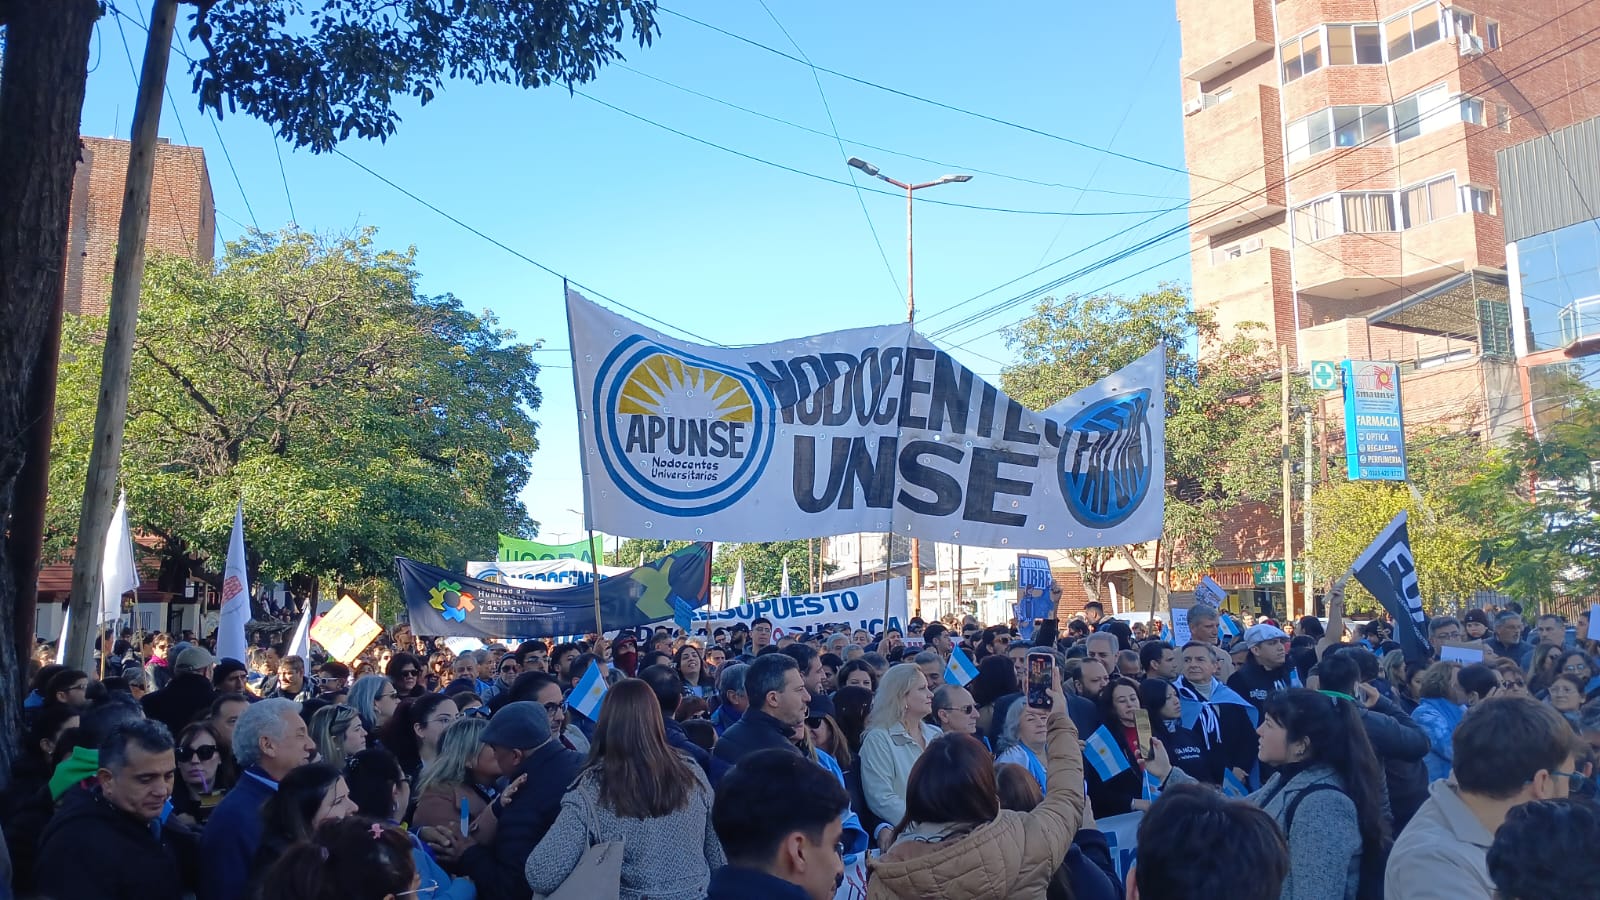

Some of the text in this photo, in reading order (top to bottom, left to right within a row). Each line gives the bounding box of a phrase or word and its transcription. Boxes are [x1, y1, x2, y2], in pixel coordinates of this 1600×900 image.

[1356, 415, 1399, 427] FARMACIA
[625, 414, 745, 459] APUNSE
[652, 456, 719, 471] Nodocentes
[651, 469, 719, 481] Universitarios
[792, 435, 1040, 527] UNSE
[478, 598, 511, 606] Ciencias
